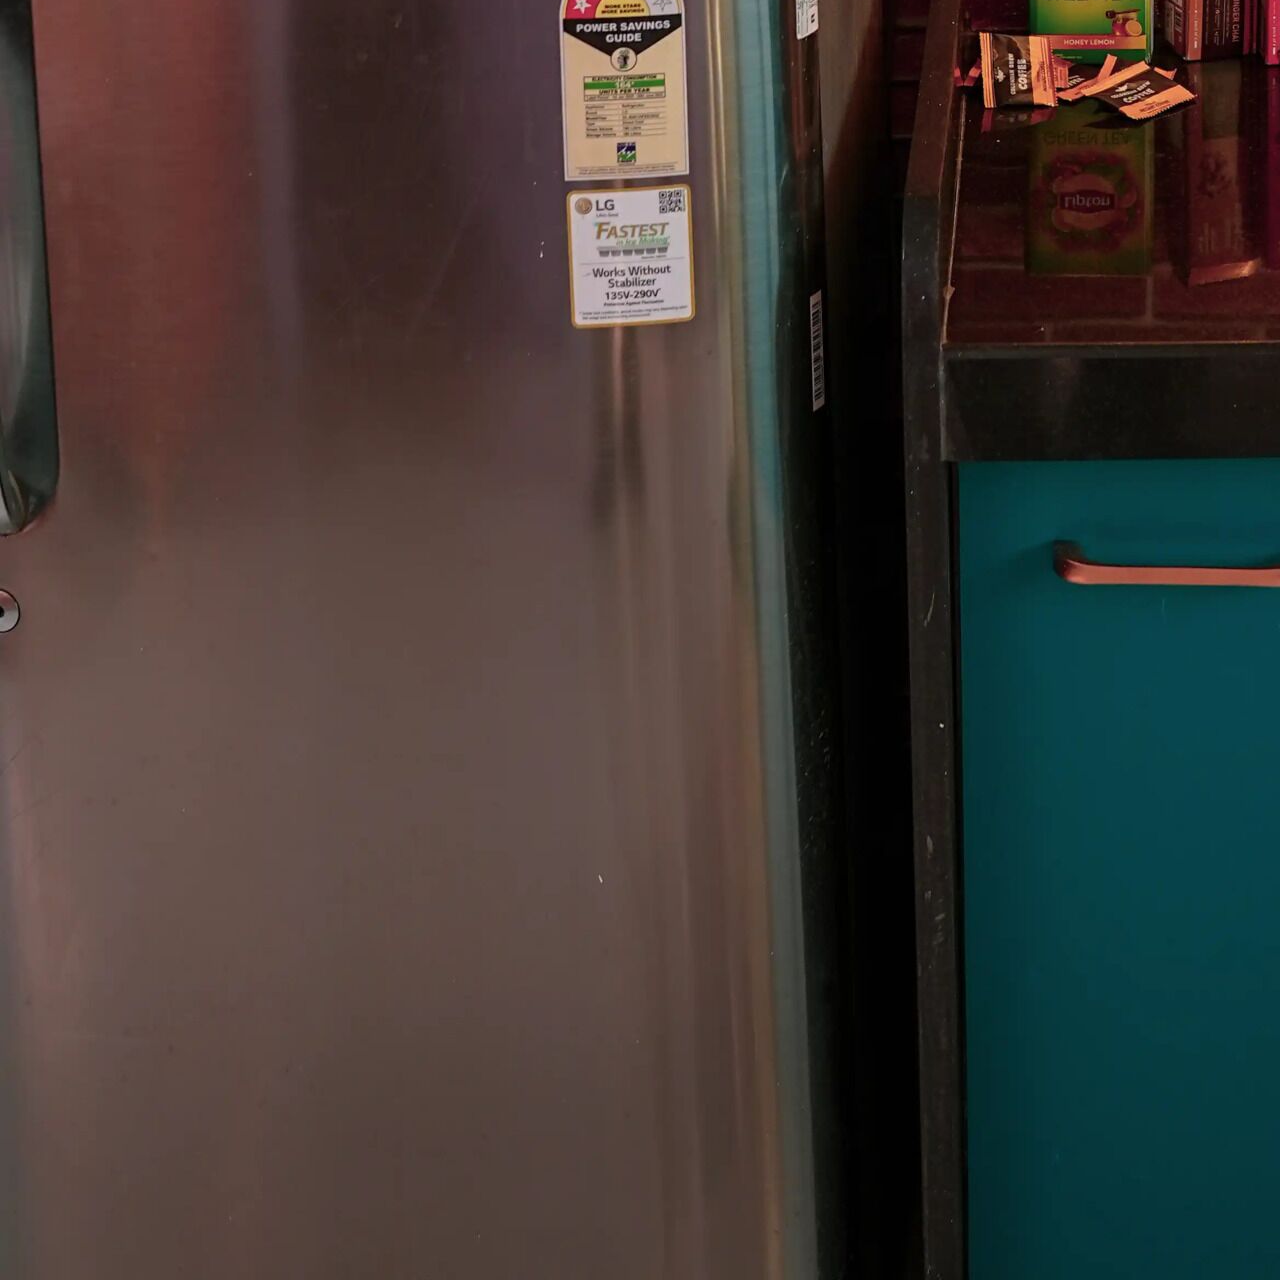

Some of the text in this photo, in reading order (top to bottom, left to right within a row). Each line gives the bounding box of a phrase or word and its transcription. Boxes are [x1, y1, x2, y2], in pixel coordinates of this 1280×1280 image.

[576, 20, 671, 33] POWER SAVINGS
[606, 33, 643, 43] GUIDE
[1017, 58, 1028, 90] COFFEE
[595, 199, 615, 211] LG
[594, 222, 669, 239] FASTEST
[592, 265, 671, 278] Works Without
[608, 278, 657, 289] Stabilizer
